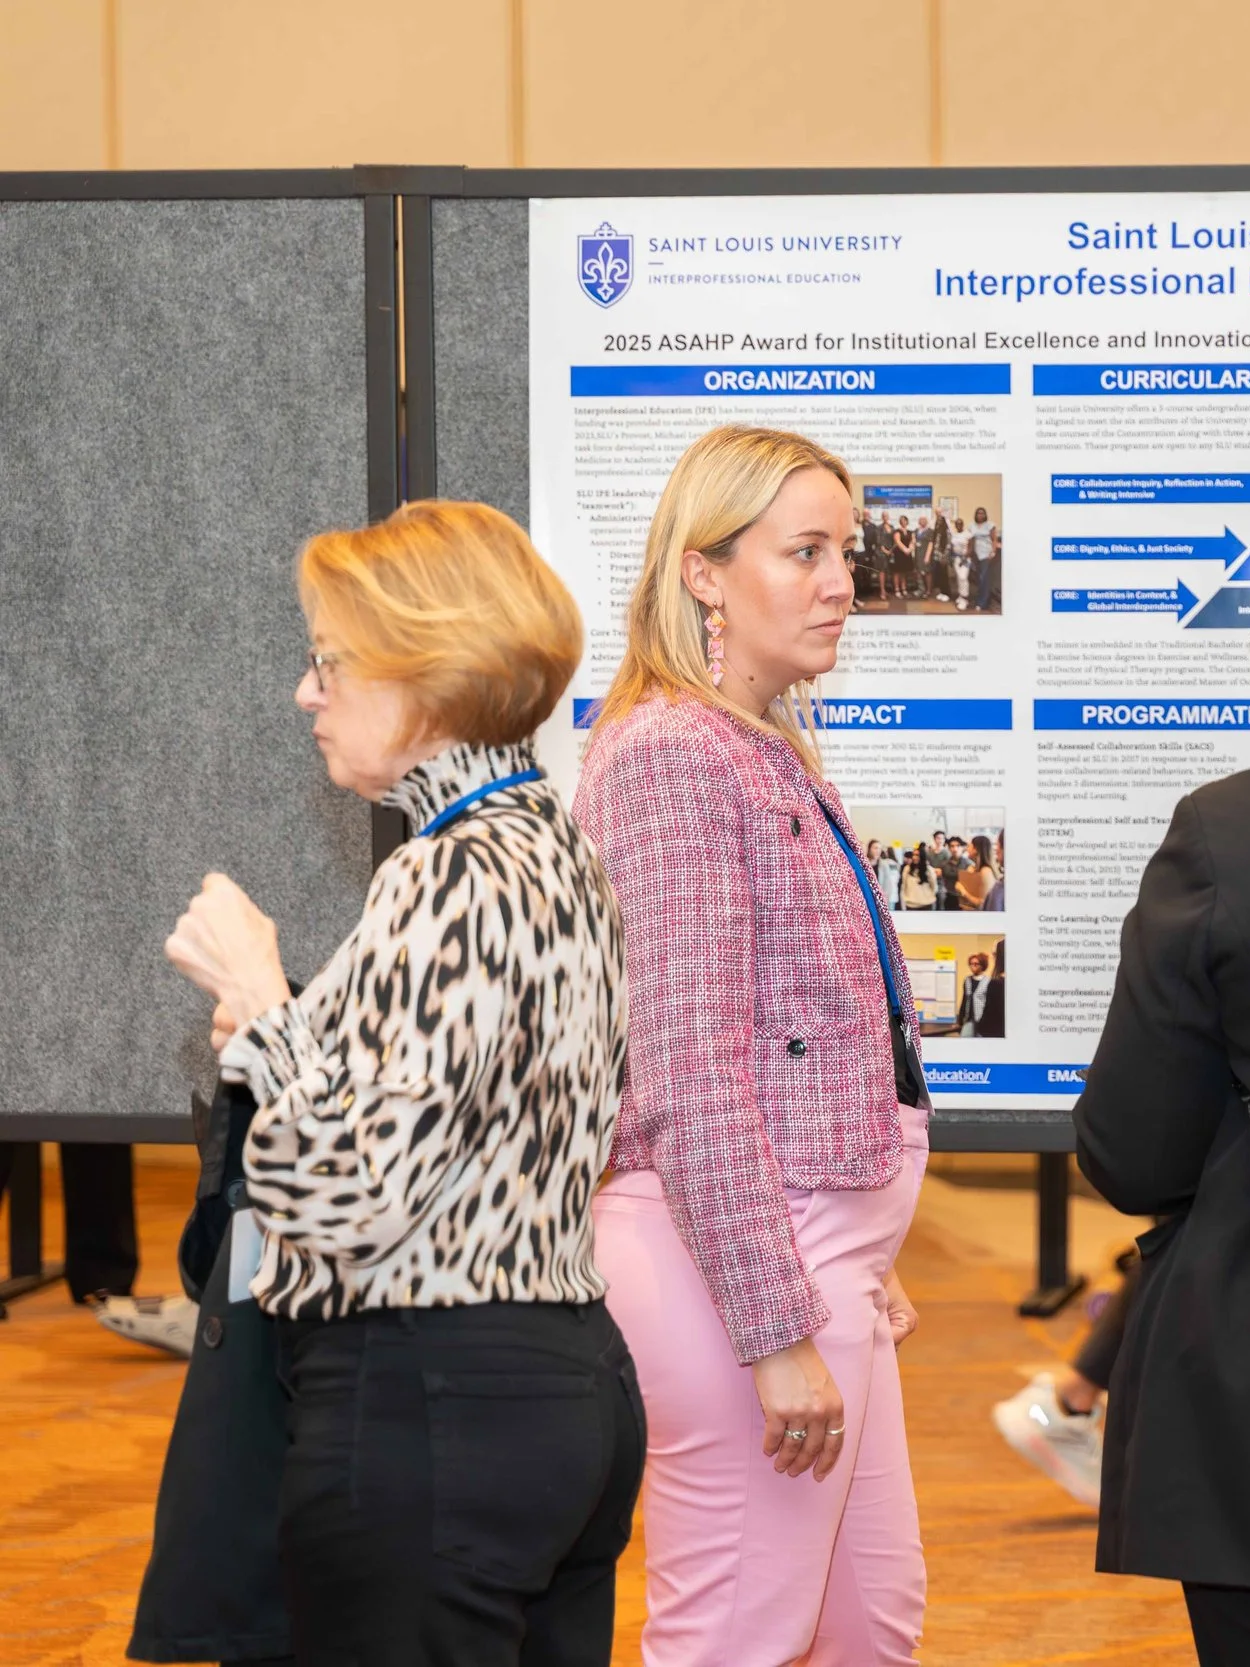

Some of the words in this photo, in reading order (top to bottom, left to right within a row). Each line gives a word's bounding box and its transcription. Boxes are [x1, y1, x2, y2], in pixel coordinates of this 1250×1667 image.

[1067, 222, 1157, 250] Saint
[649, 238, 707, 252] SAINT
[716, 237, 774, 251] LOUIS
[783, 236, 902, 251] UNIVERSITY
[649, 274, 782, 284] INTERPROFESSIONAL
[787, 273, 861, 283] EDUCATION
[935, 267, 1236, 303] Interprofessional
[604, 334, 651, 351] 2025
[659, 333, 734, 351] ASAHP
[742, 333, 808, 351] Award
[816, 332, 844, 350] for
[852, 332, 976, 350] Institutional
[985, 331, 1099, 349] Excellence
[1107, 330, 1146, 349] and
[703, 370, 875, 391] ORGANIZATION
[1054, 479, 1077, 488] CORE:
[1079, 479, 1131, 487] Collaborative
[1132, 479, 1163, 489] Inquiry,
[1164, 479, 1203, 487] Reflection
[1206, 479, 1213, 487] in
[1215, 479, 1244, 488] Action,
[1079, 491, 1086, 499] &
[1087, 491, 1118, 500] Writing
[1119, 491, 1154, 499] Intensive
[1054, 545, 1078, 553] CORE:
[1080, 545, 1109, 554] Dignity,
[1111, 545, 1137, 554] Ethics,
[1139, 545, 1145, 553] &
[1147, 545, 1162, 553] Just
[1164, 545, 1193, 554] Society
[1087, 591, 1124, 599] Identities
[1136, 592, 1169, 600] Context,
[1115, 603, 1182, 612] Interdependence
[823, 705, 906, 724] IMPACT
